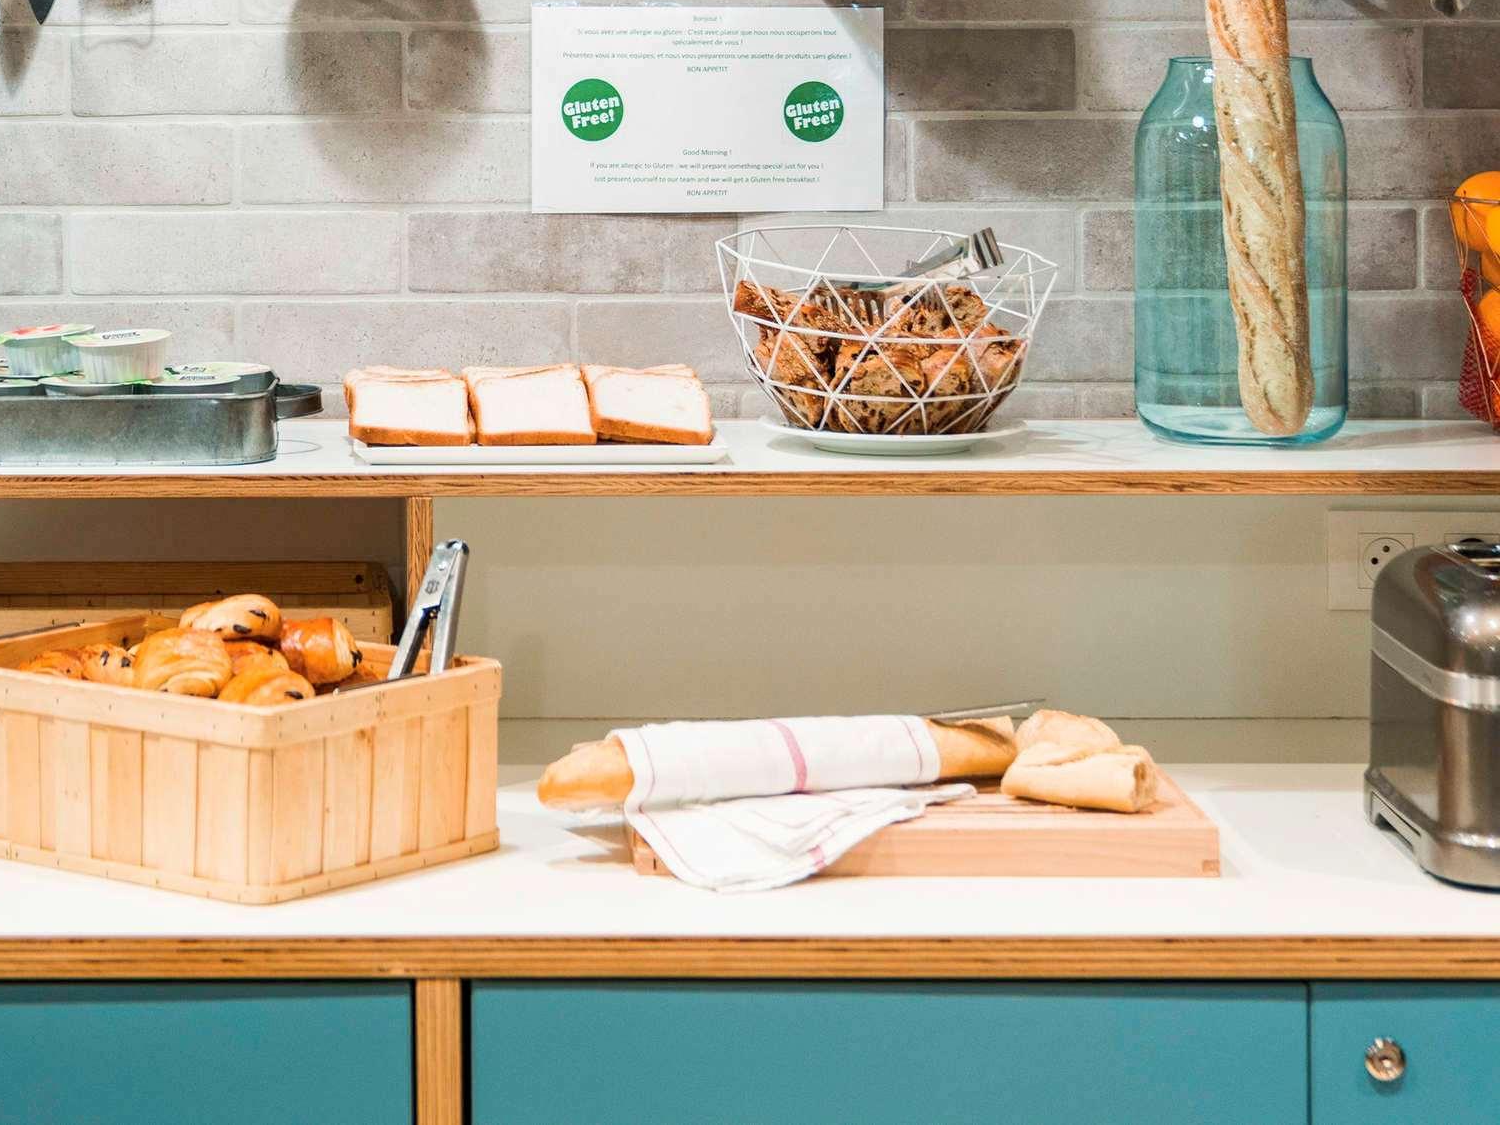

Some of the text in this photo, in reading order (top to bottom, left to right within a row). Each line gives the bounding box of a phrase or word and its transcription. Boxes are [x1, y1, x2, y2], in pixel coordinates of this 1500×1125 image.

[563, 96, 620, 116] Gluten
[785, 98, 840, 118] Gluten
[571, 109, 615, 129] Free!
[793, 111, 835, 130] Free!
